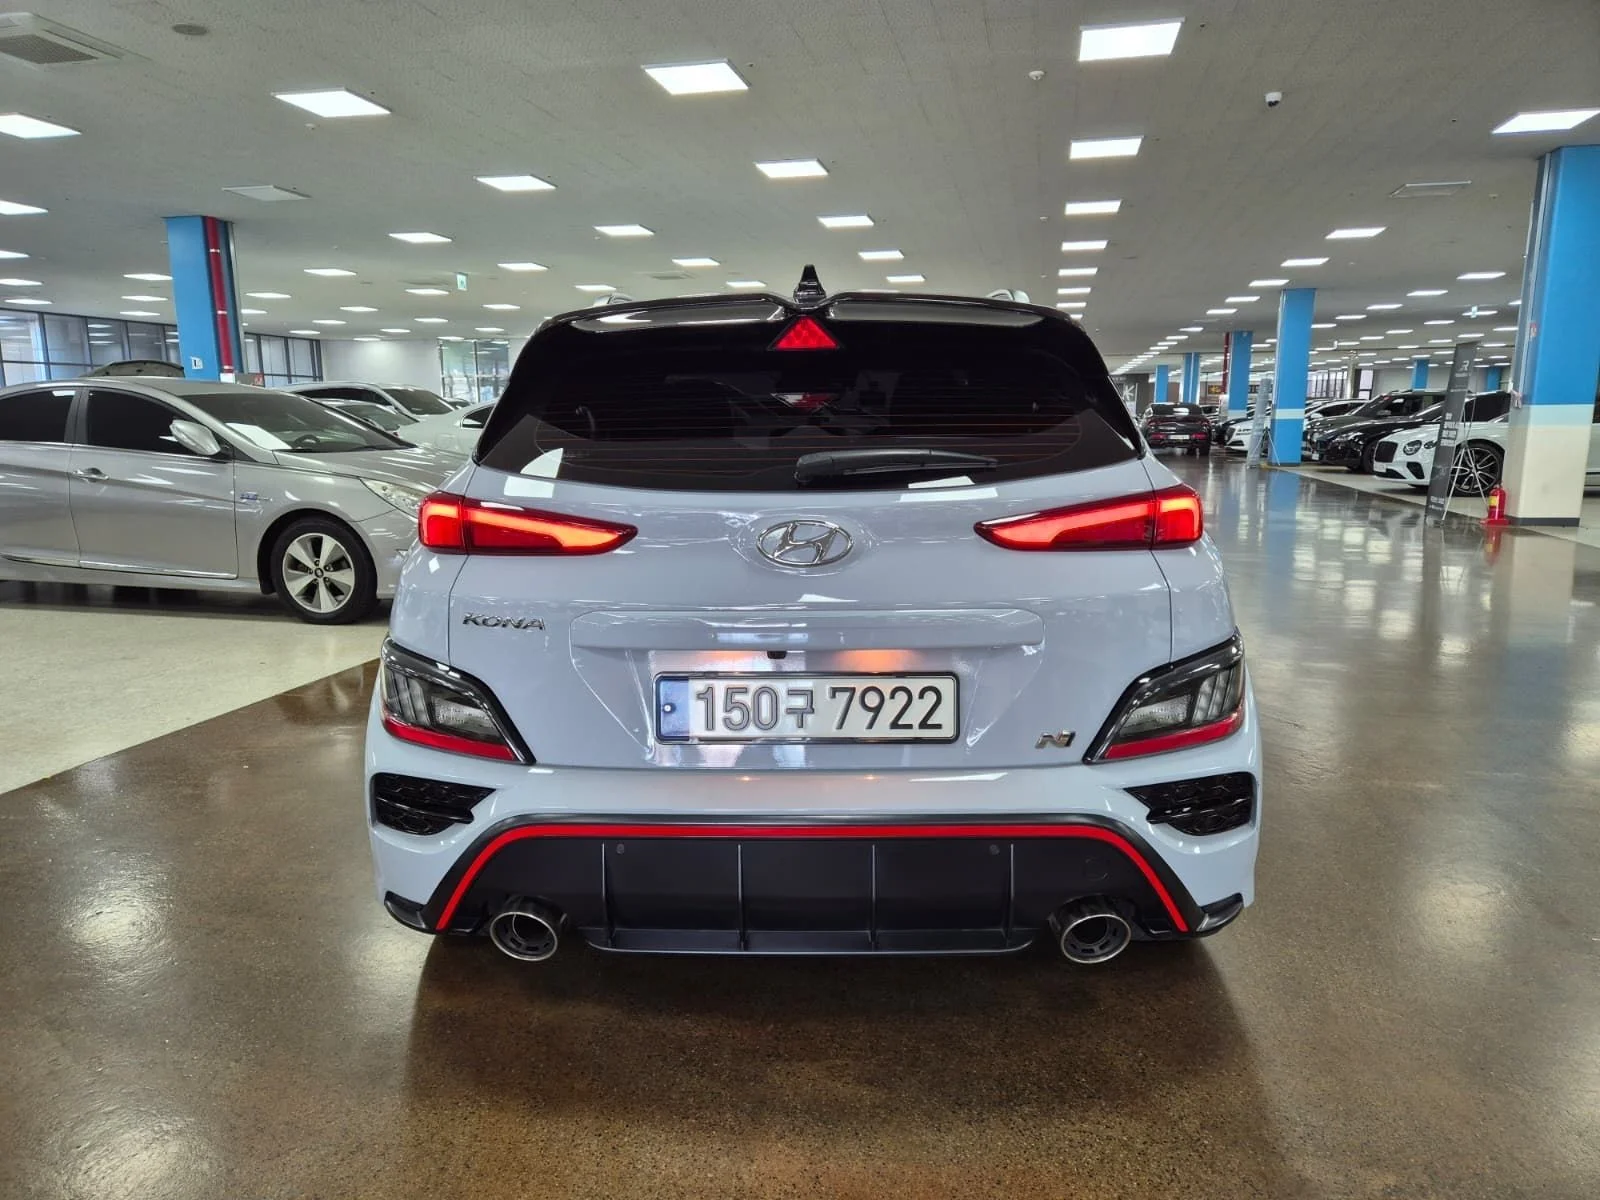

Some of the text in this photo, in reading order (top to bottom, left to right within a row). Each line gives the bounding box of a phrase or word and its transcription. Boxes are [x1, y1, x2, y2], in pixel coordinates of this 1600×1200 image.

[462, 612, 546, 631] KONA
[696, 685, 944, 731] 150구 7922
